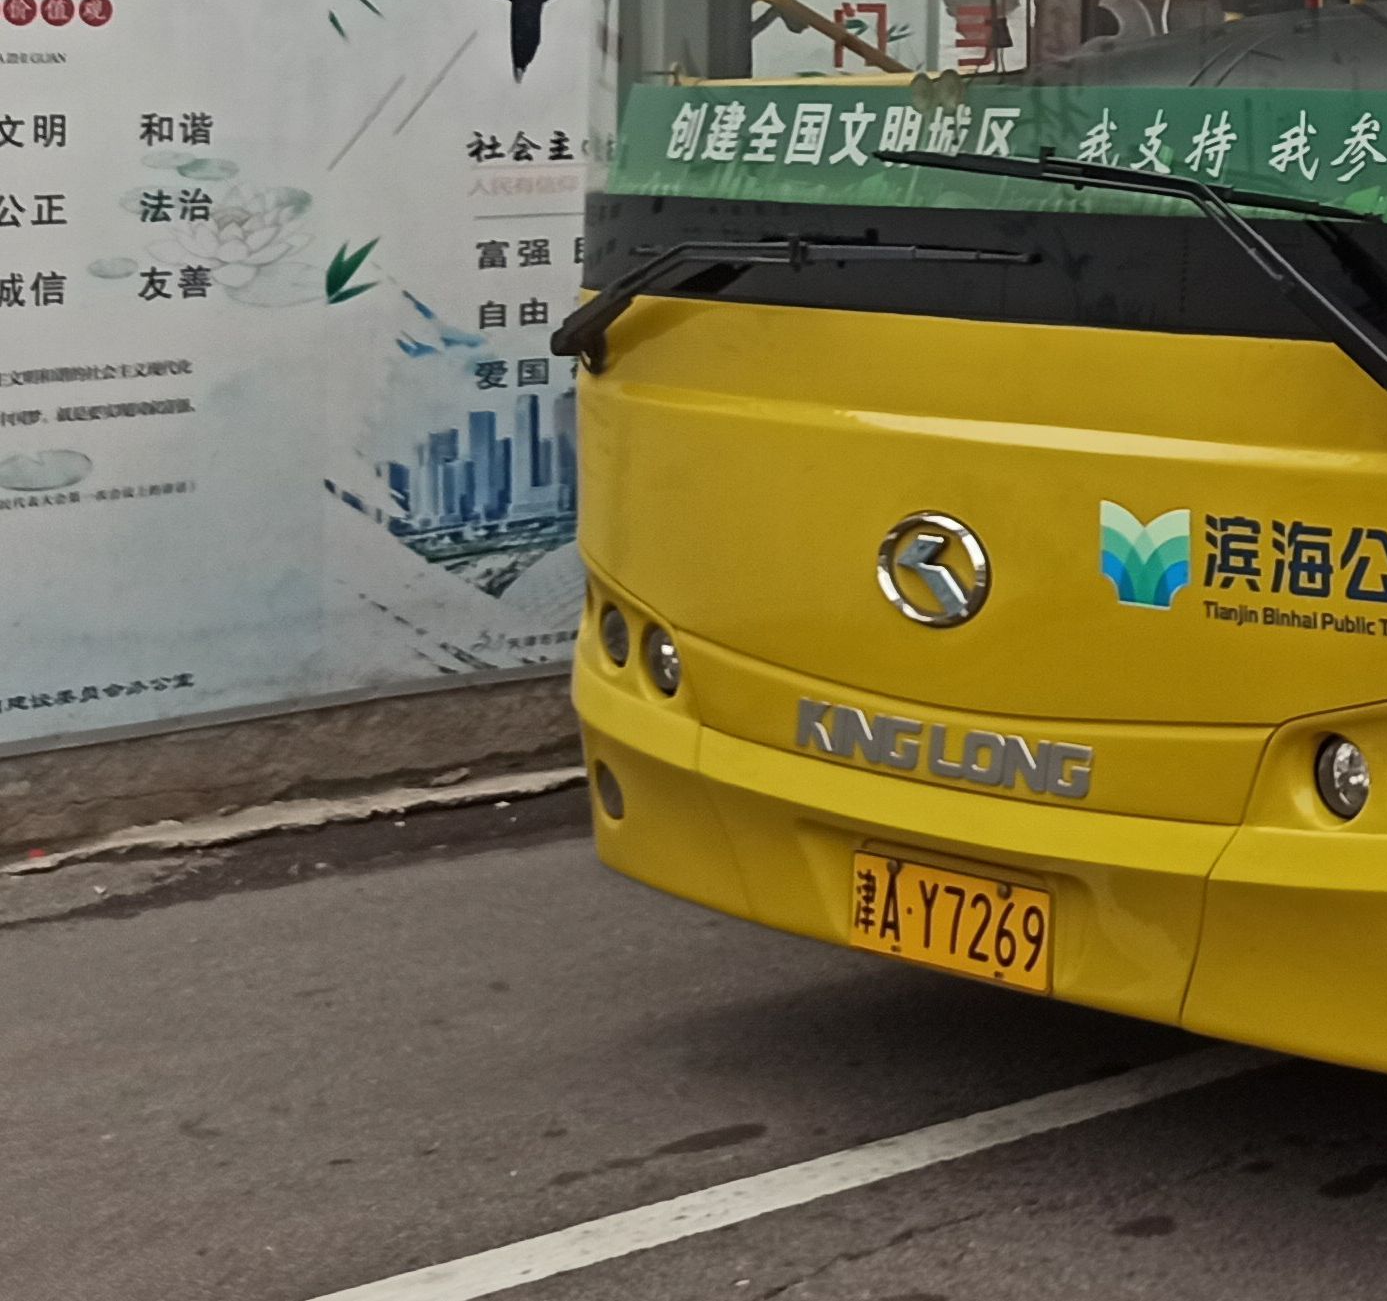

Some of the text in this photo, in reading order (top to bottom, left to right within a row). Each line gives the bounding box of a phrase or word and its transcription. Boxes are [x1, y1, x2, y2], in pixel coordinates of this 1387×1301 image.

[139, 112, 213, 147] 和谐
[666, 100, 1021, 168] 创建全国文明城区
[1076, 107, 1238, 179] 我支持
[139, 187, 213, 223] 法治
[475, 238, 552, 270] 富强
[138, 264, 213, 301] 友善
[479, 296, 549, 330] 自由
[474, 357, 550, 391] 爱国
[1203, 600, 1259, 627] Tianjin
[1262, 607, 1318, 630] Binhai
[1321, 612, 1376, 637] Public
[795, 696, 1093, 799] KING LONG
